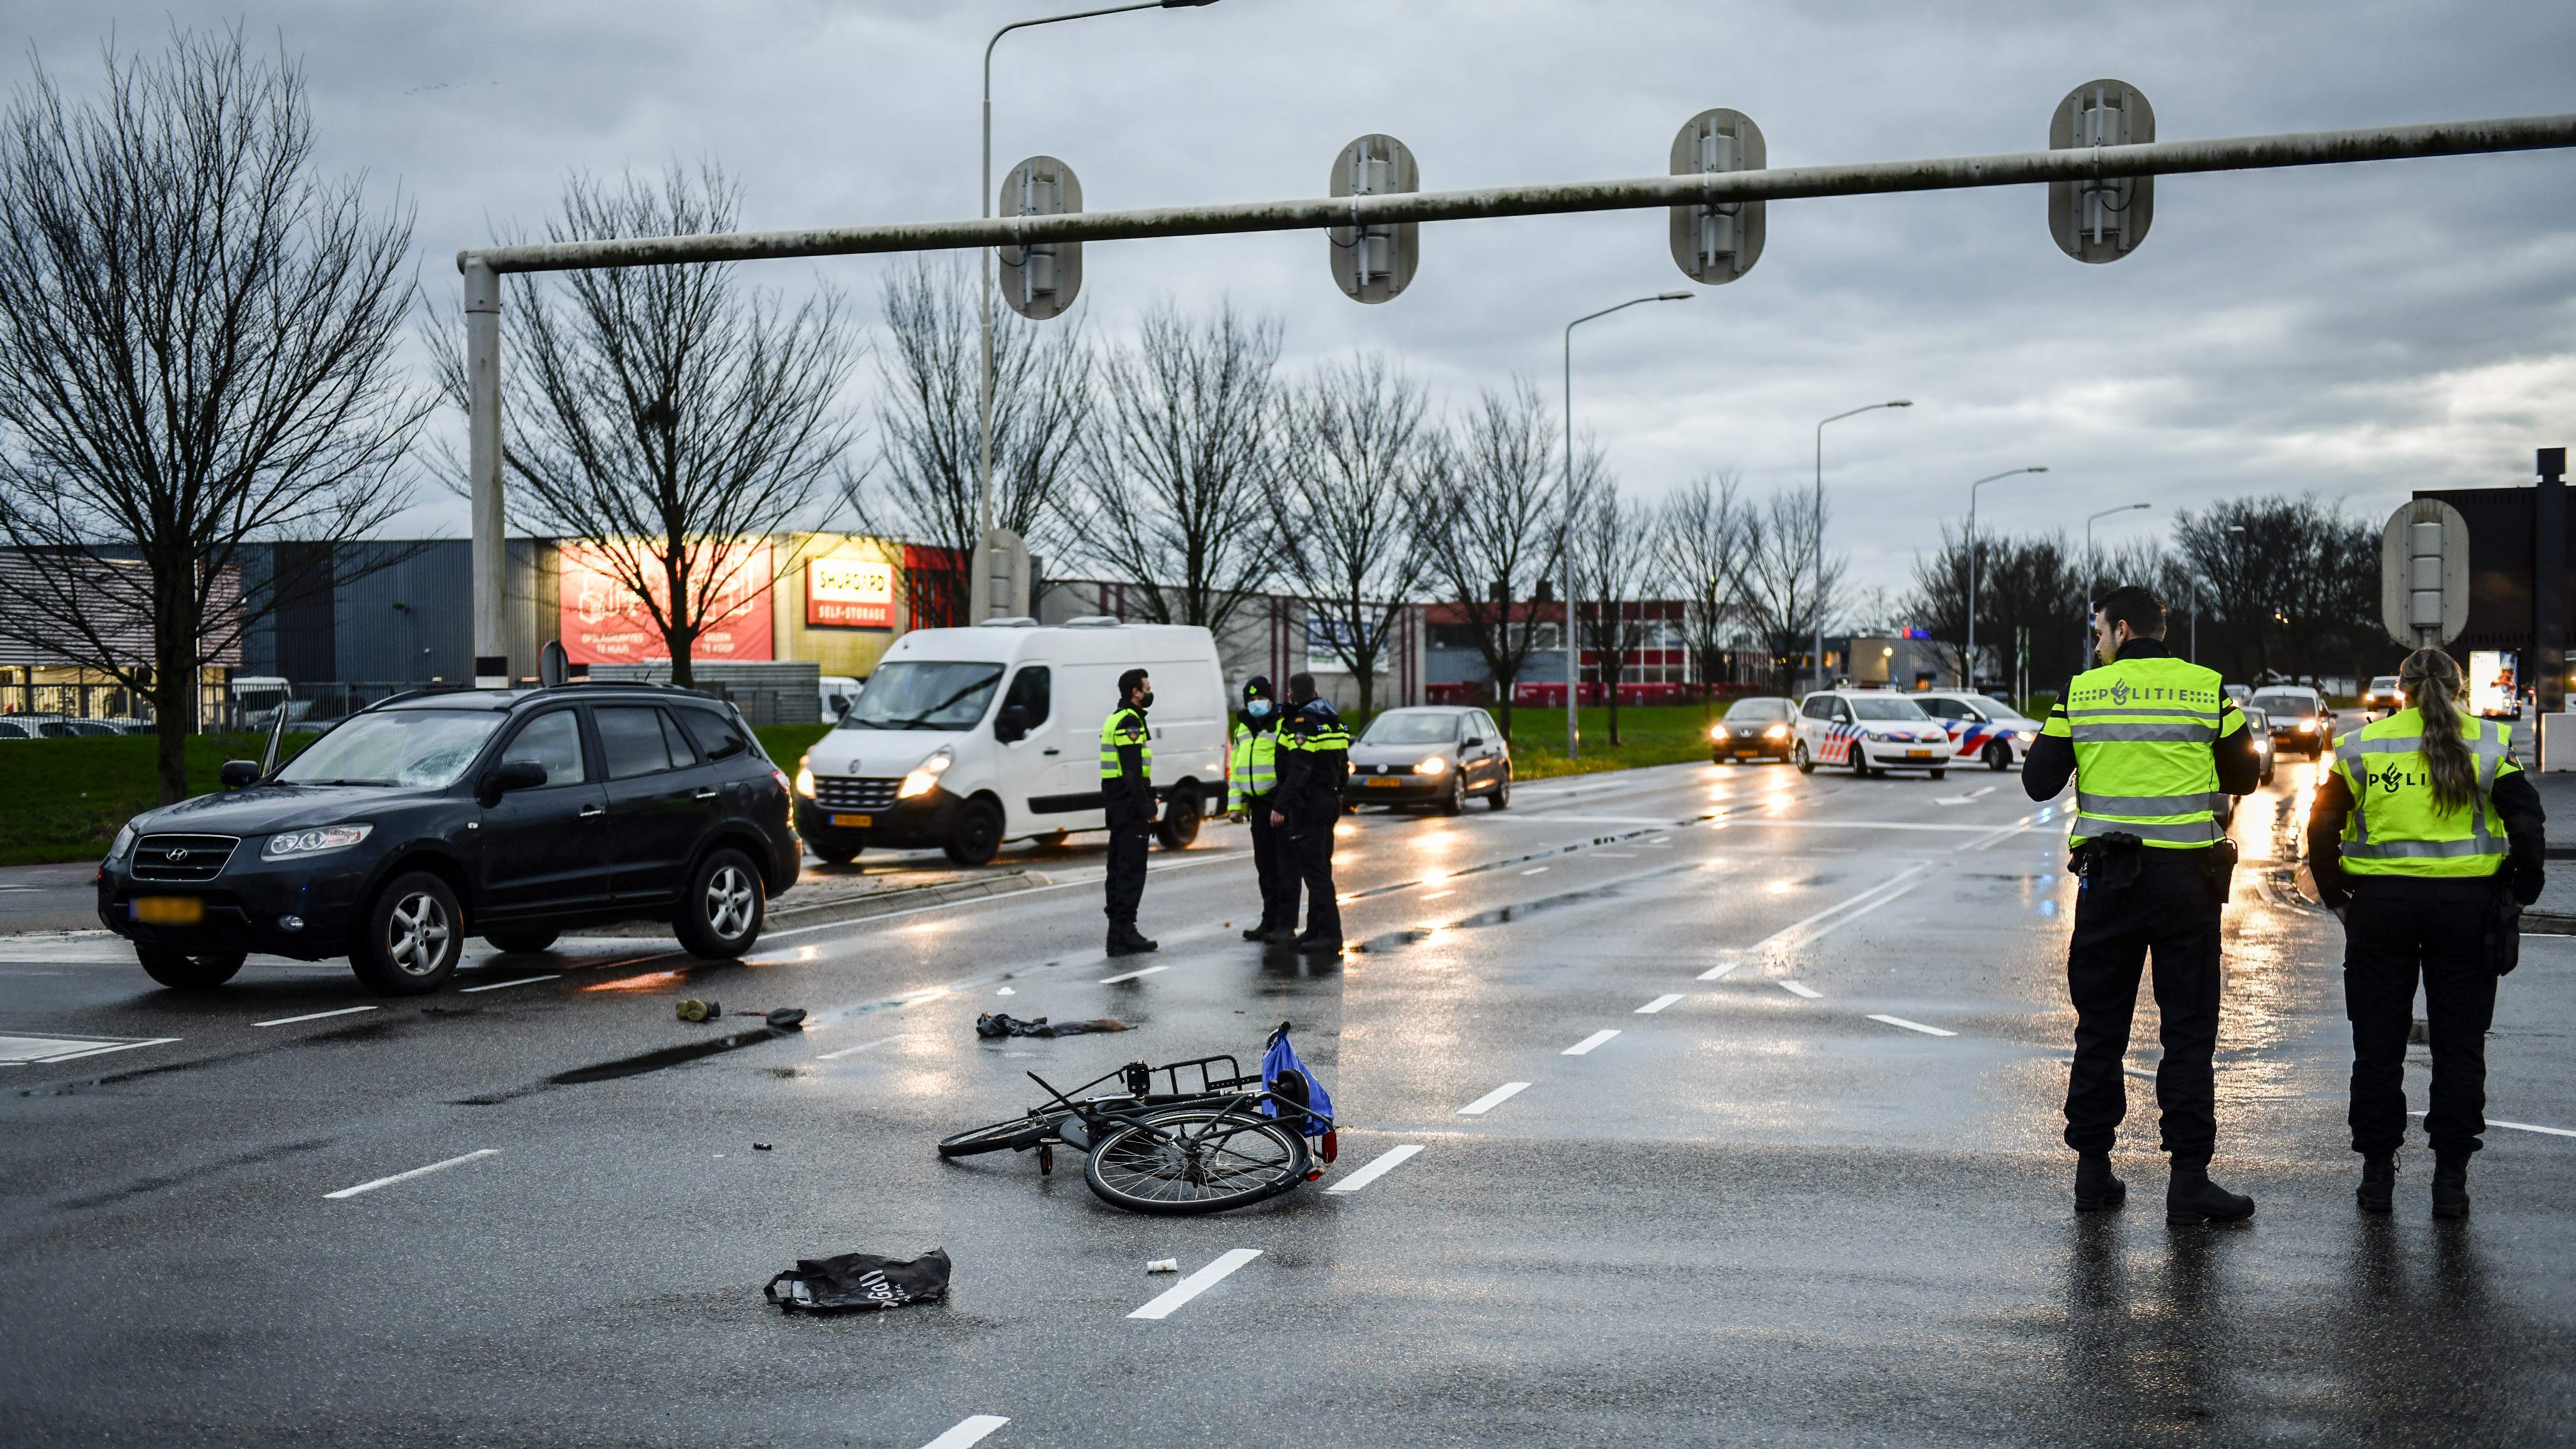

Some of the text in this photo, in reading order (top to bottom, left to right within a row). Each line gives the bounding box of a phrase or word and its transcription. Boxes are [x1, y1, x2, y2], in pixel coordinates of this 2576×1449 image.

[820, 570, 885, 591] SHURGARD
[819, 605, 886, 622] SELF-STORAGE
[859, 1269, 893, 1299] Gall
